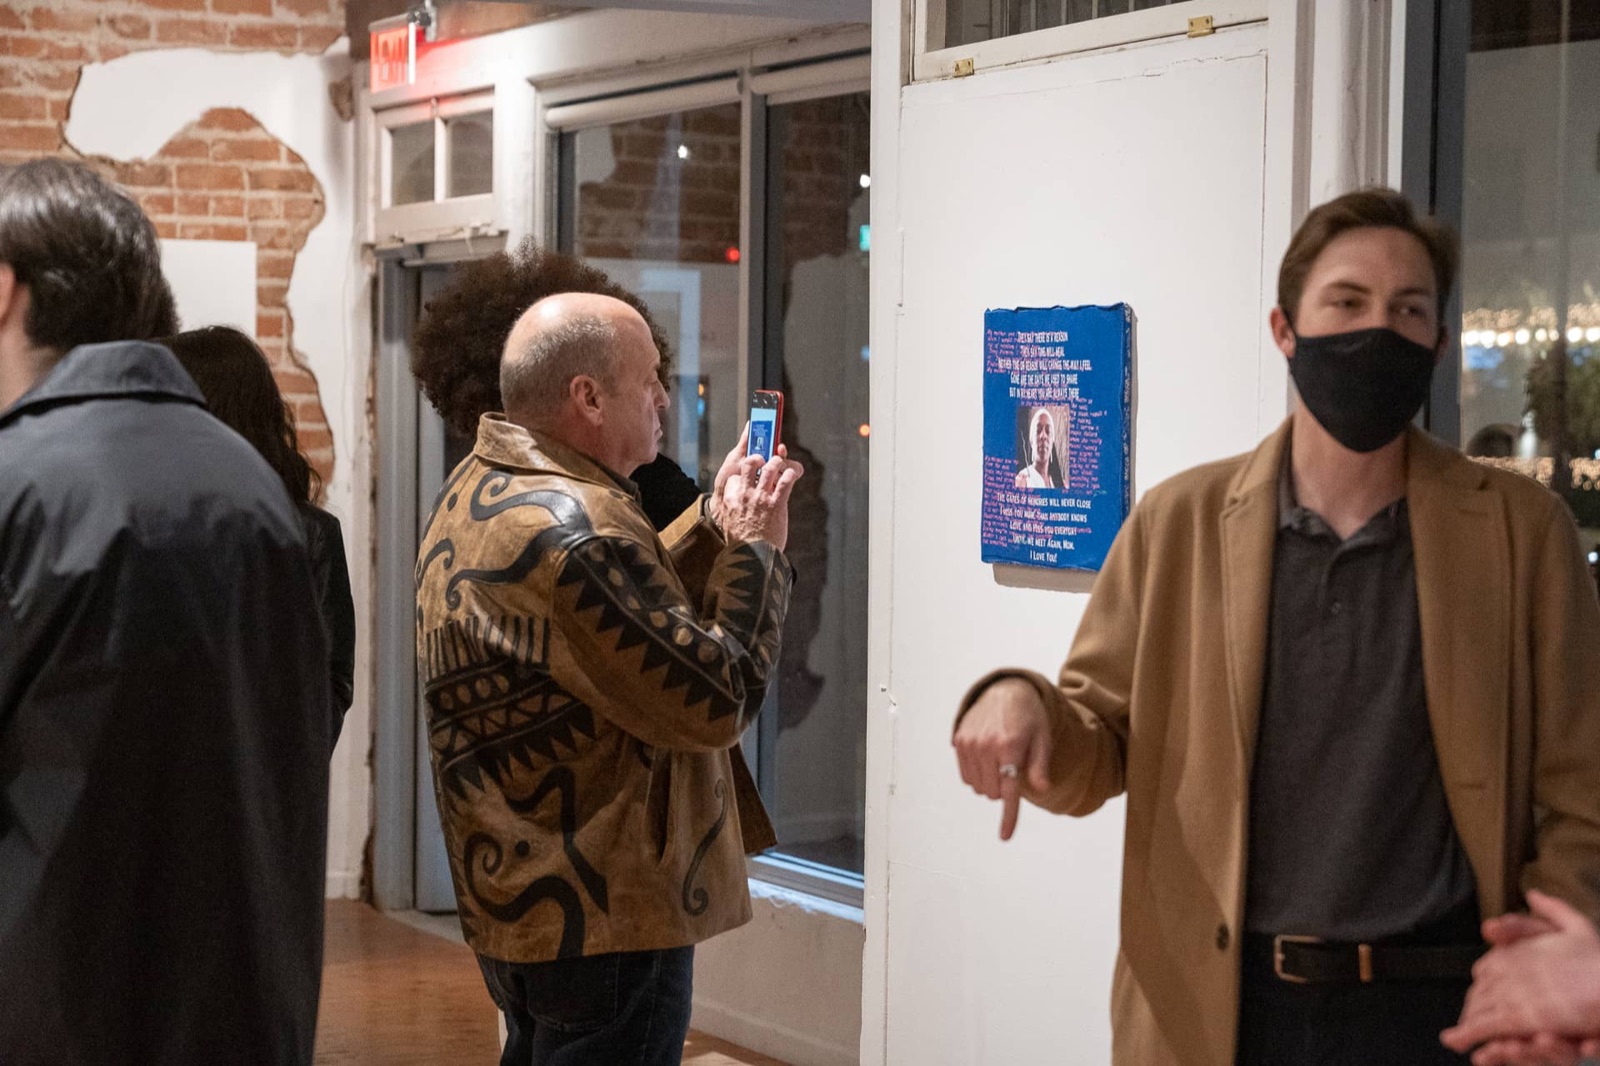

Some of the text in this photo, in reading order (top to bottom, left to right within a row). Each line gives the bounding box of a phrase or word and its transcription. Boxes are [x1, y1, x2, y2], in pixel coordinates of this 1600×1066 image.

[1050, 498, 1060, 507] WILL
[1061, 498, 1075, 507] NEVER
[1076, 499, 1091, 509] CLOSE
[1050, 512, 1069, 521] ANYBODY
[1071, 513, 1087, 523] KNOWS
[1009, 520, 1021, 531] LOVE
[1035, 538, 1046, 547] MEET
[1033, 551, 1045, 562] LOVE
